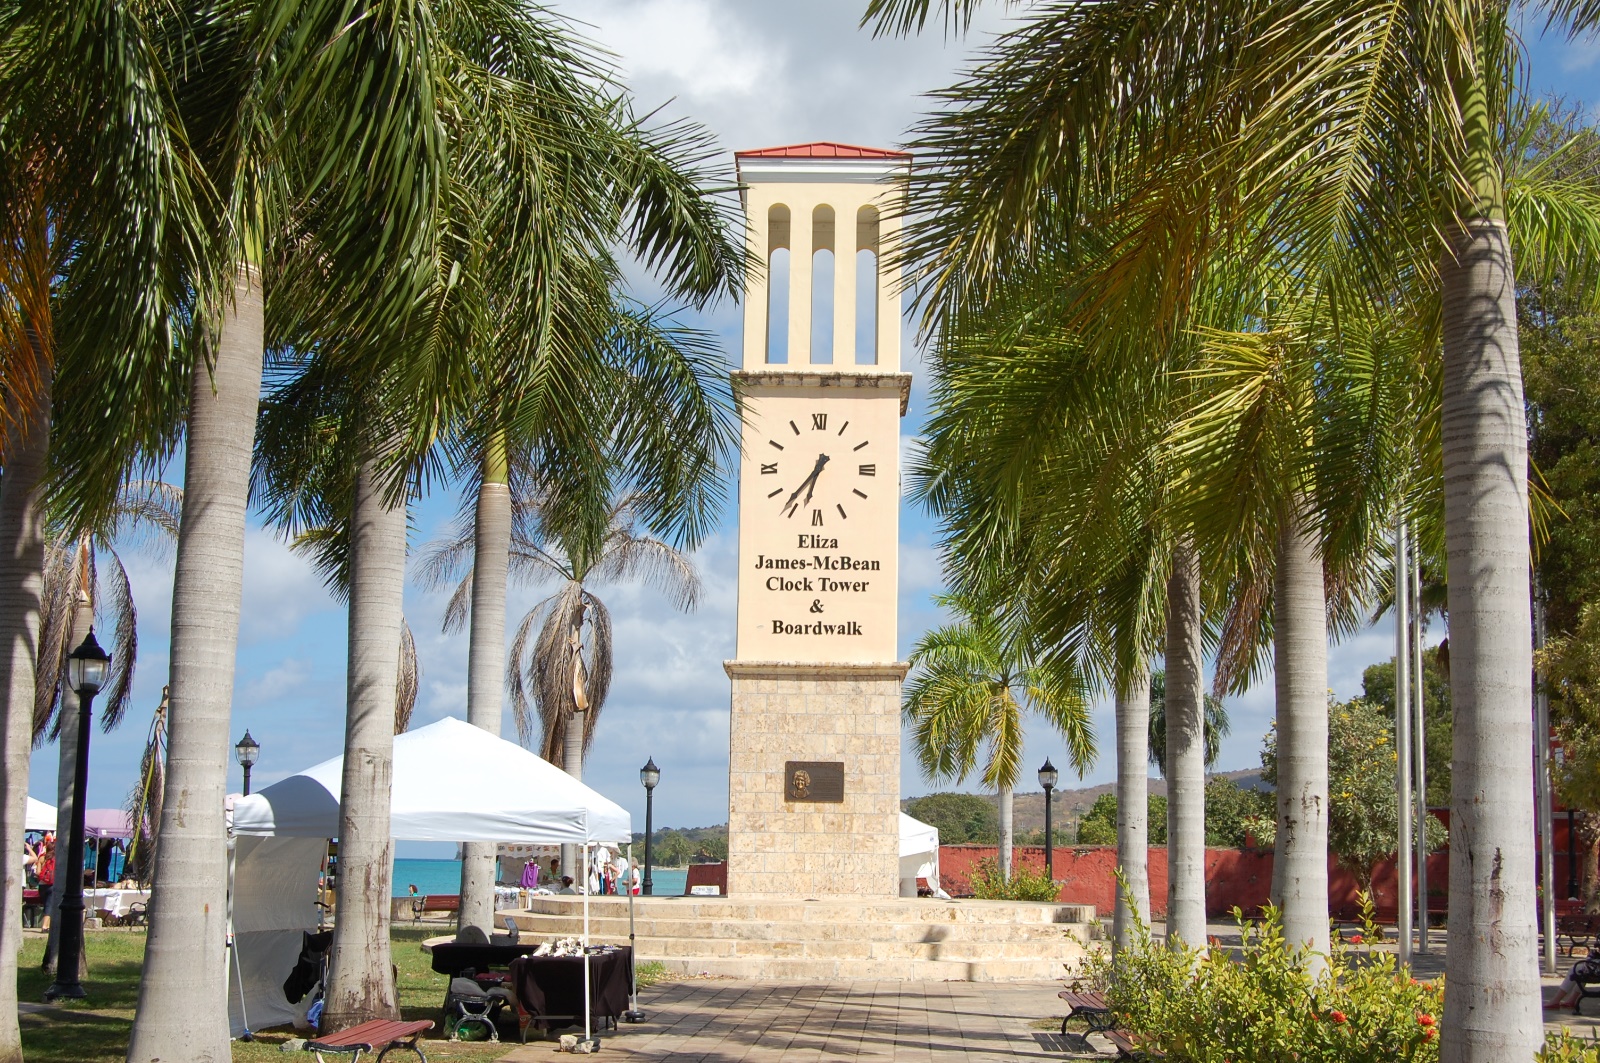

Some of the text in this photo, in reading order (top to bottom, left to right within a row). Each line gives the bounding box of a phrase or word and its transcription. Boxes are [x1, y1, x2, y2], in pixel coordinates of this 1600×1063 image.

[811, 413, 828, 431] XII
[858, 463, 876, 477] III
[797, 534, 839, 549] Eliza
[754, 554, 881, 571] James-McBean
[765, 576, 870, 593] Clock Tower
[809, 598, 824, 614] &
[771, 619, 863, 636] Boardwalk
